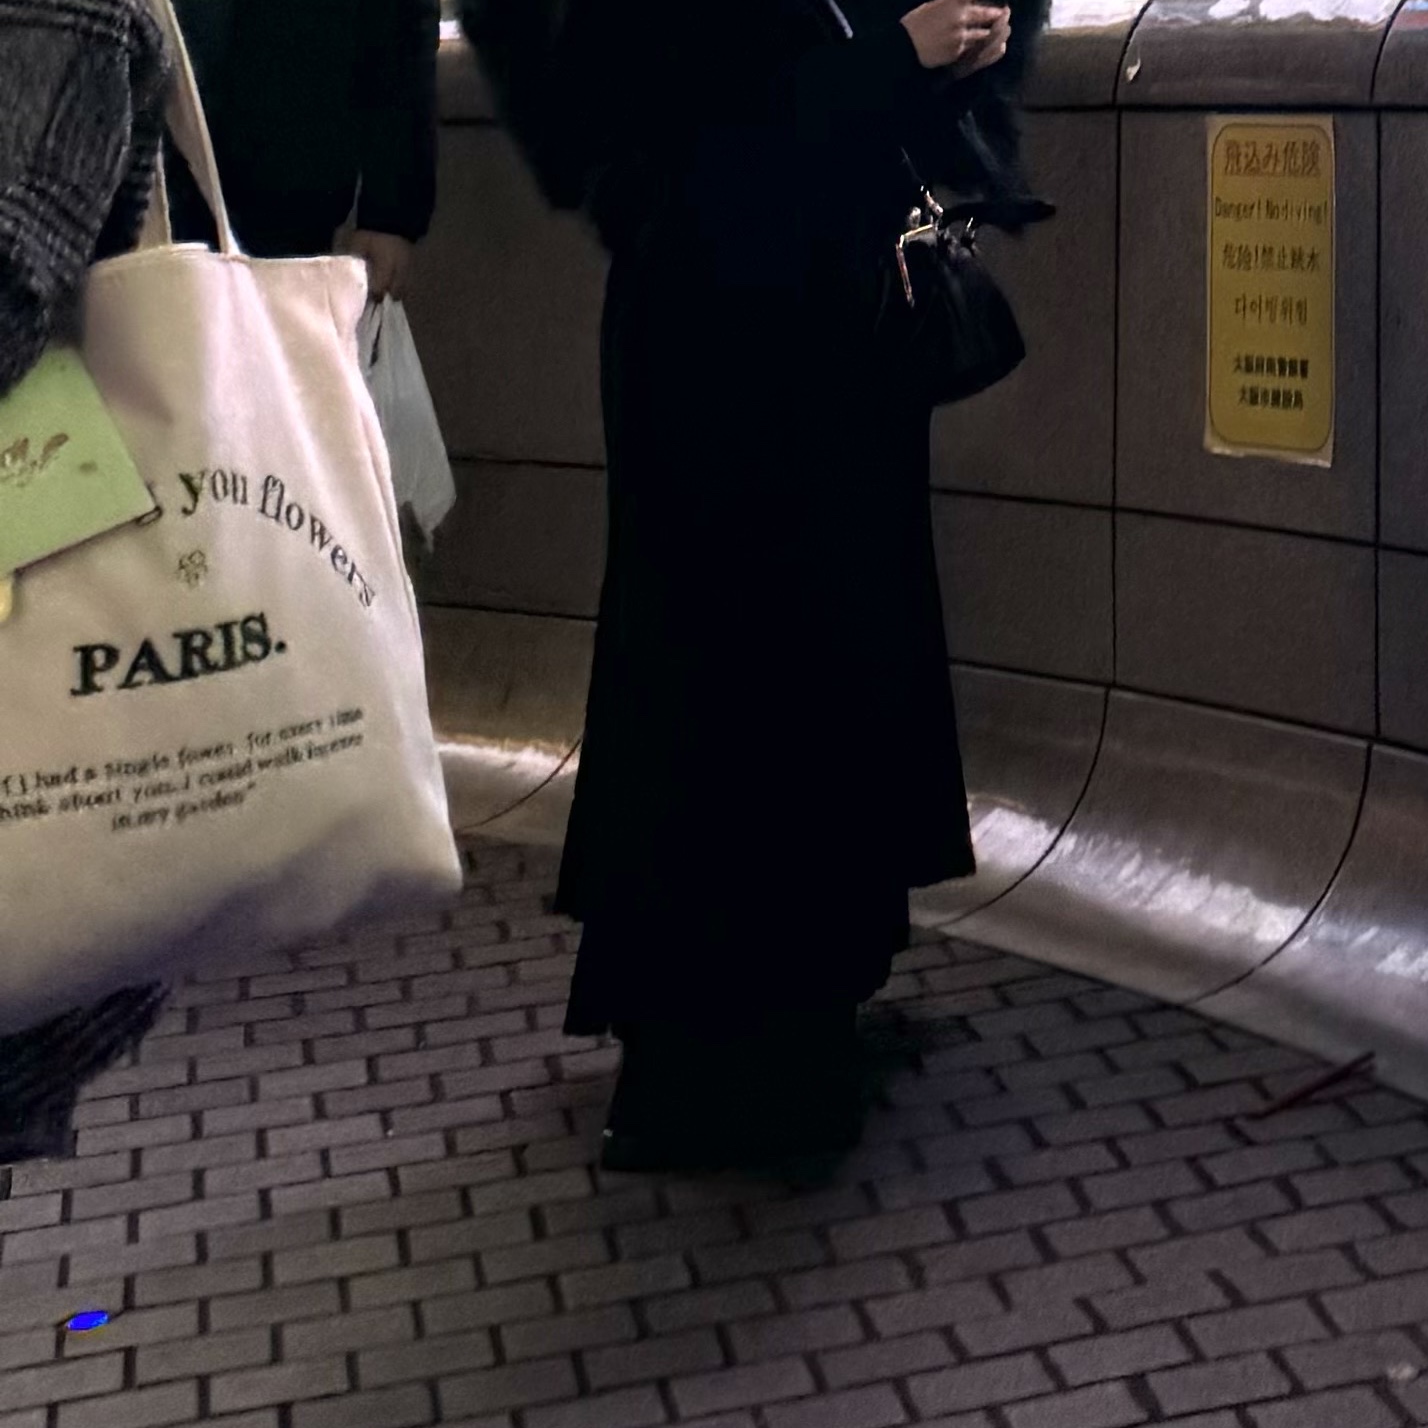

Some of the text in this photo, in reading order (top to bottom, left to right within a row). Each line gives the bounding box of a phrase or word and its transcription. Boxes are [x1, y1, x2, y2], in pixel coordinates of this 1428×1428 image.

[178, 468, 377, 608] you flowers
[69, 611, 288, 698] PARIS.
